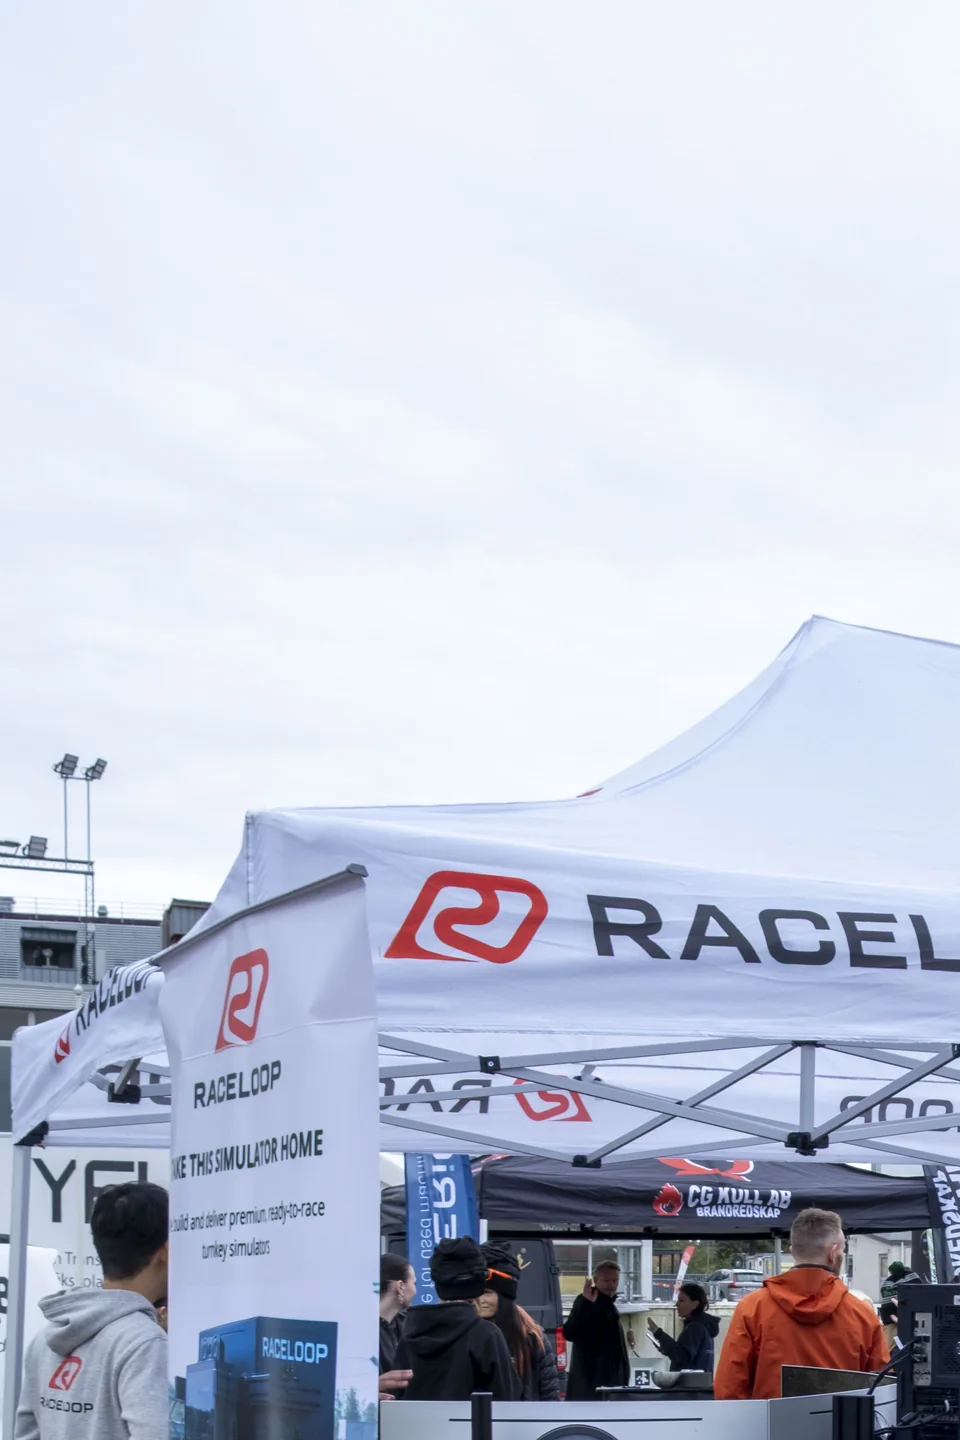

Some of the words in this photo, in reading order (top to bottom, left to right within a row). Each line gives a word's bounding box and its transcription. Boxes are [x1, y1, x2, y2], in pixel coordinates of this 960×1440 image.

[193, 1060, 281, 1109] RACELOOP
[189, 1149, 214, 1178] THIS
[215, 1137, 278, 1173] SIMULATOR
[280, 1129, 324, 1161] HOME
[687, 1184, 714, 1208] CG
[717, 1186, 764, 1206] KULL
[767, 1189, 792, 1209] AB
[190, 1211, 204, 1231] and
[205, 1210, 228, 1229] deliver
[267, 1200, 326, 1225] ready-to-race
[696, 1203, 781, 1219] BRANDREDSKAP
[202, 1240, 228, 1262] turnkey
[229, 1237, 270, 1257] simulators
[262, 1336, 329, 1364] RACELOOP
